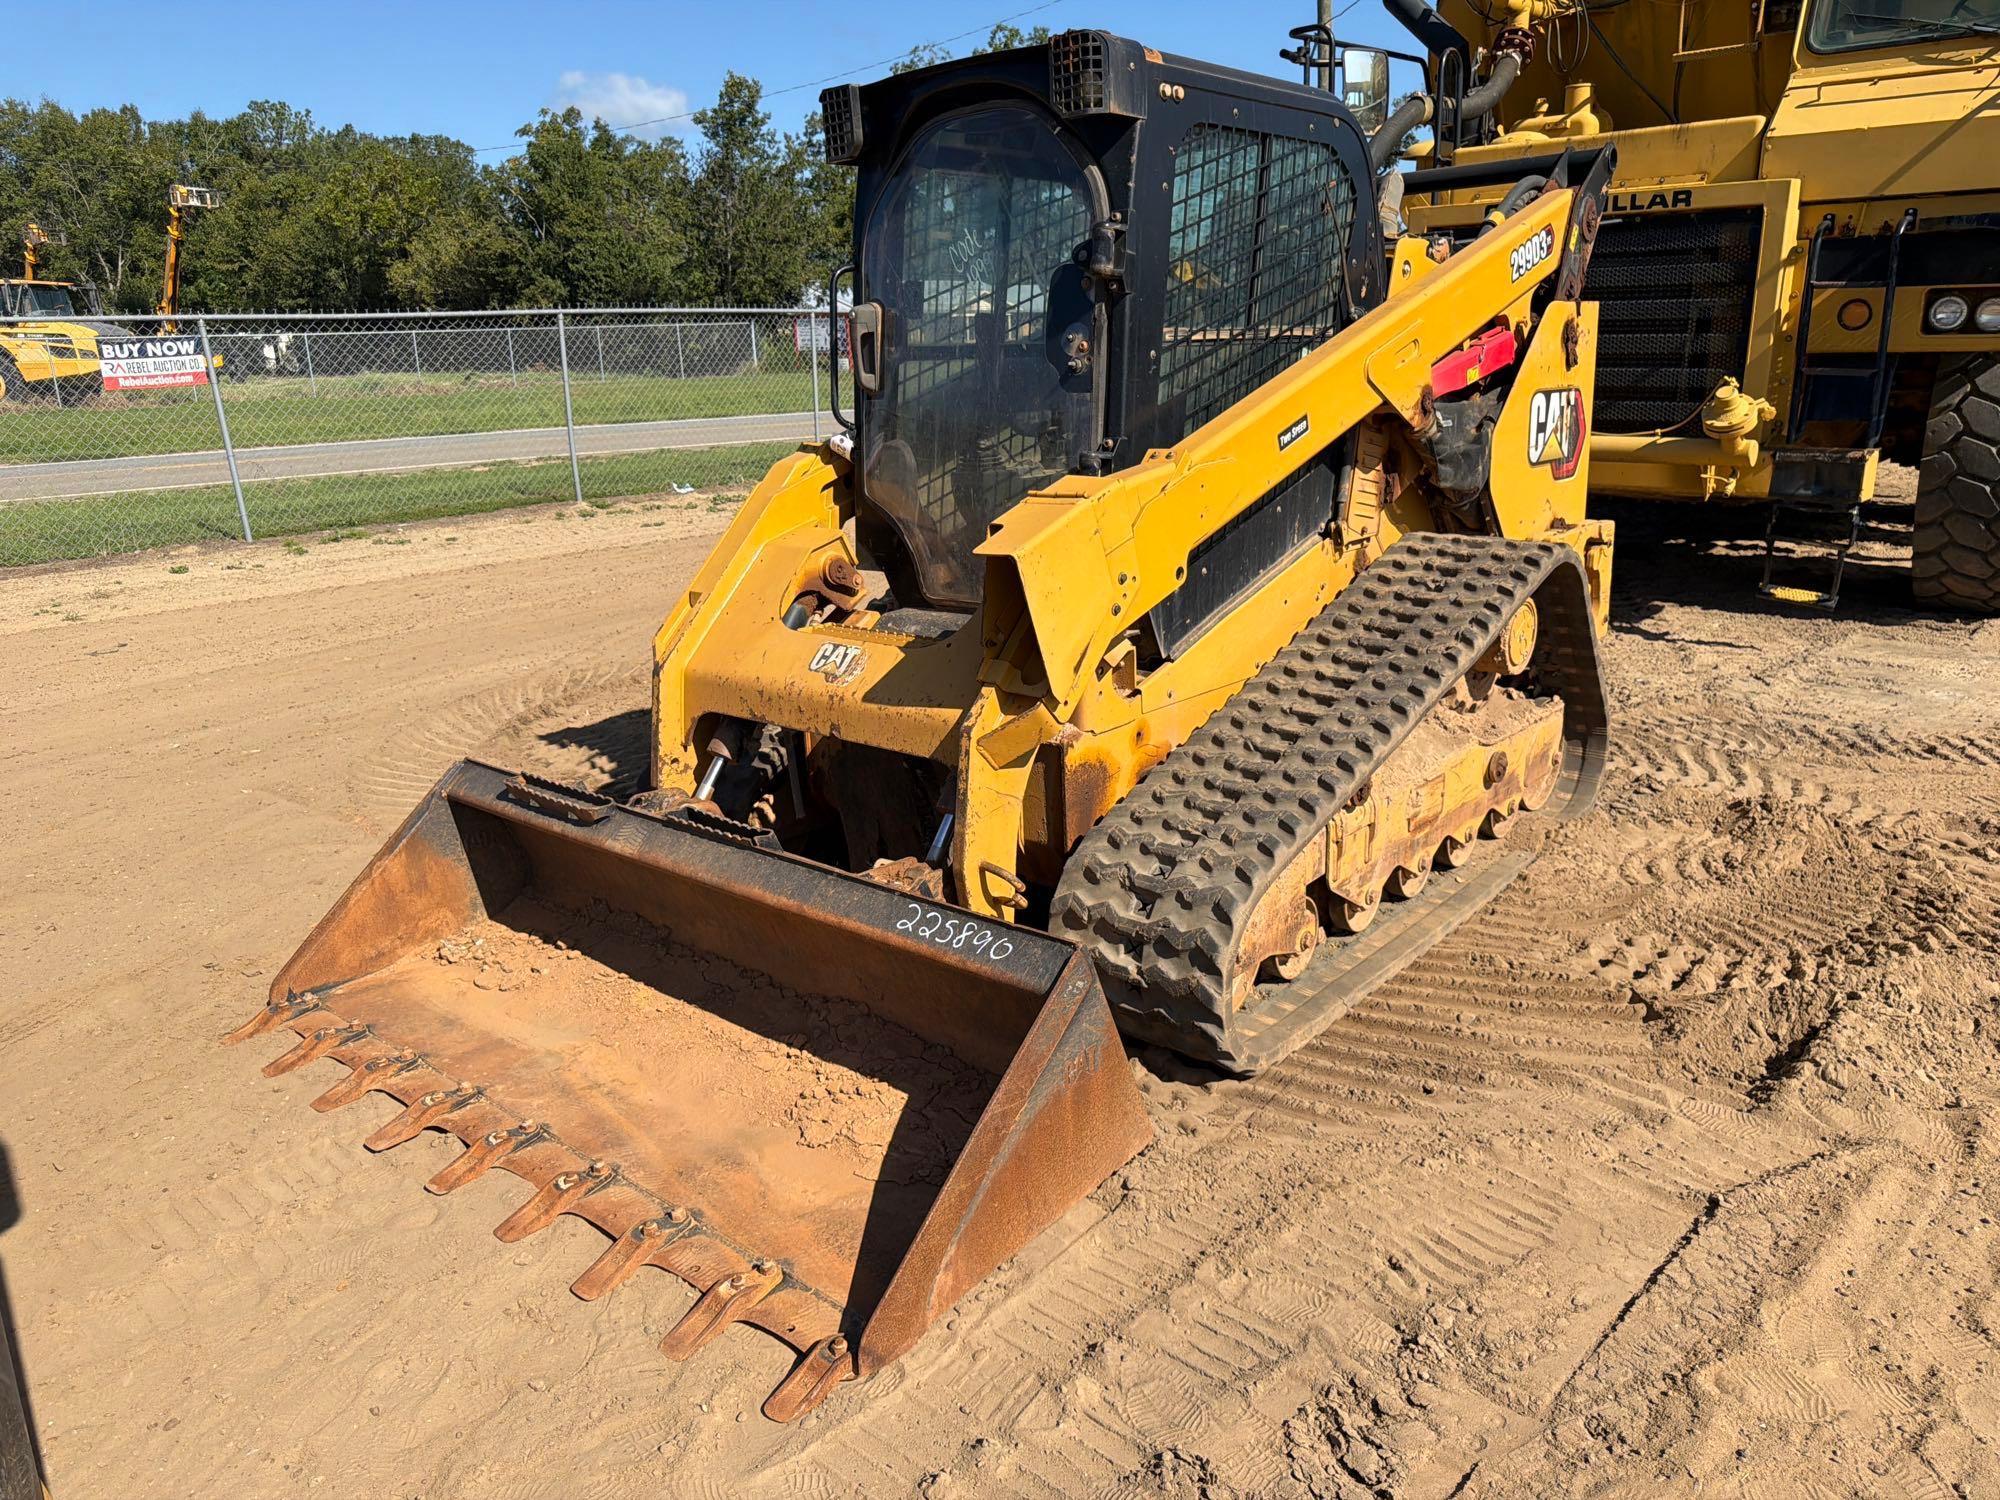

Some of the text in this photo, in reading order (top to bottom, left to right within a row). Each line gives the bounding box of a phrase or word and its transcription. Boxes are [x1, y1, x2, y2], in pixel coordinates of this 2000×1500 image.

[1511, 230, 1547, 281] 299D3
[101, 340, 195, 359] BUY NOW
[126, 358, 203, 374] REBEL AUCTION CO.
[119, 374, 194, 387] RebelAuction.com
[1529, 391, 1576, 463] CAT
[809, 643, 862, 676] CAT
[896, 903, 1013, 960] 225890
